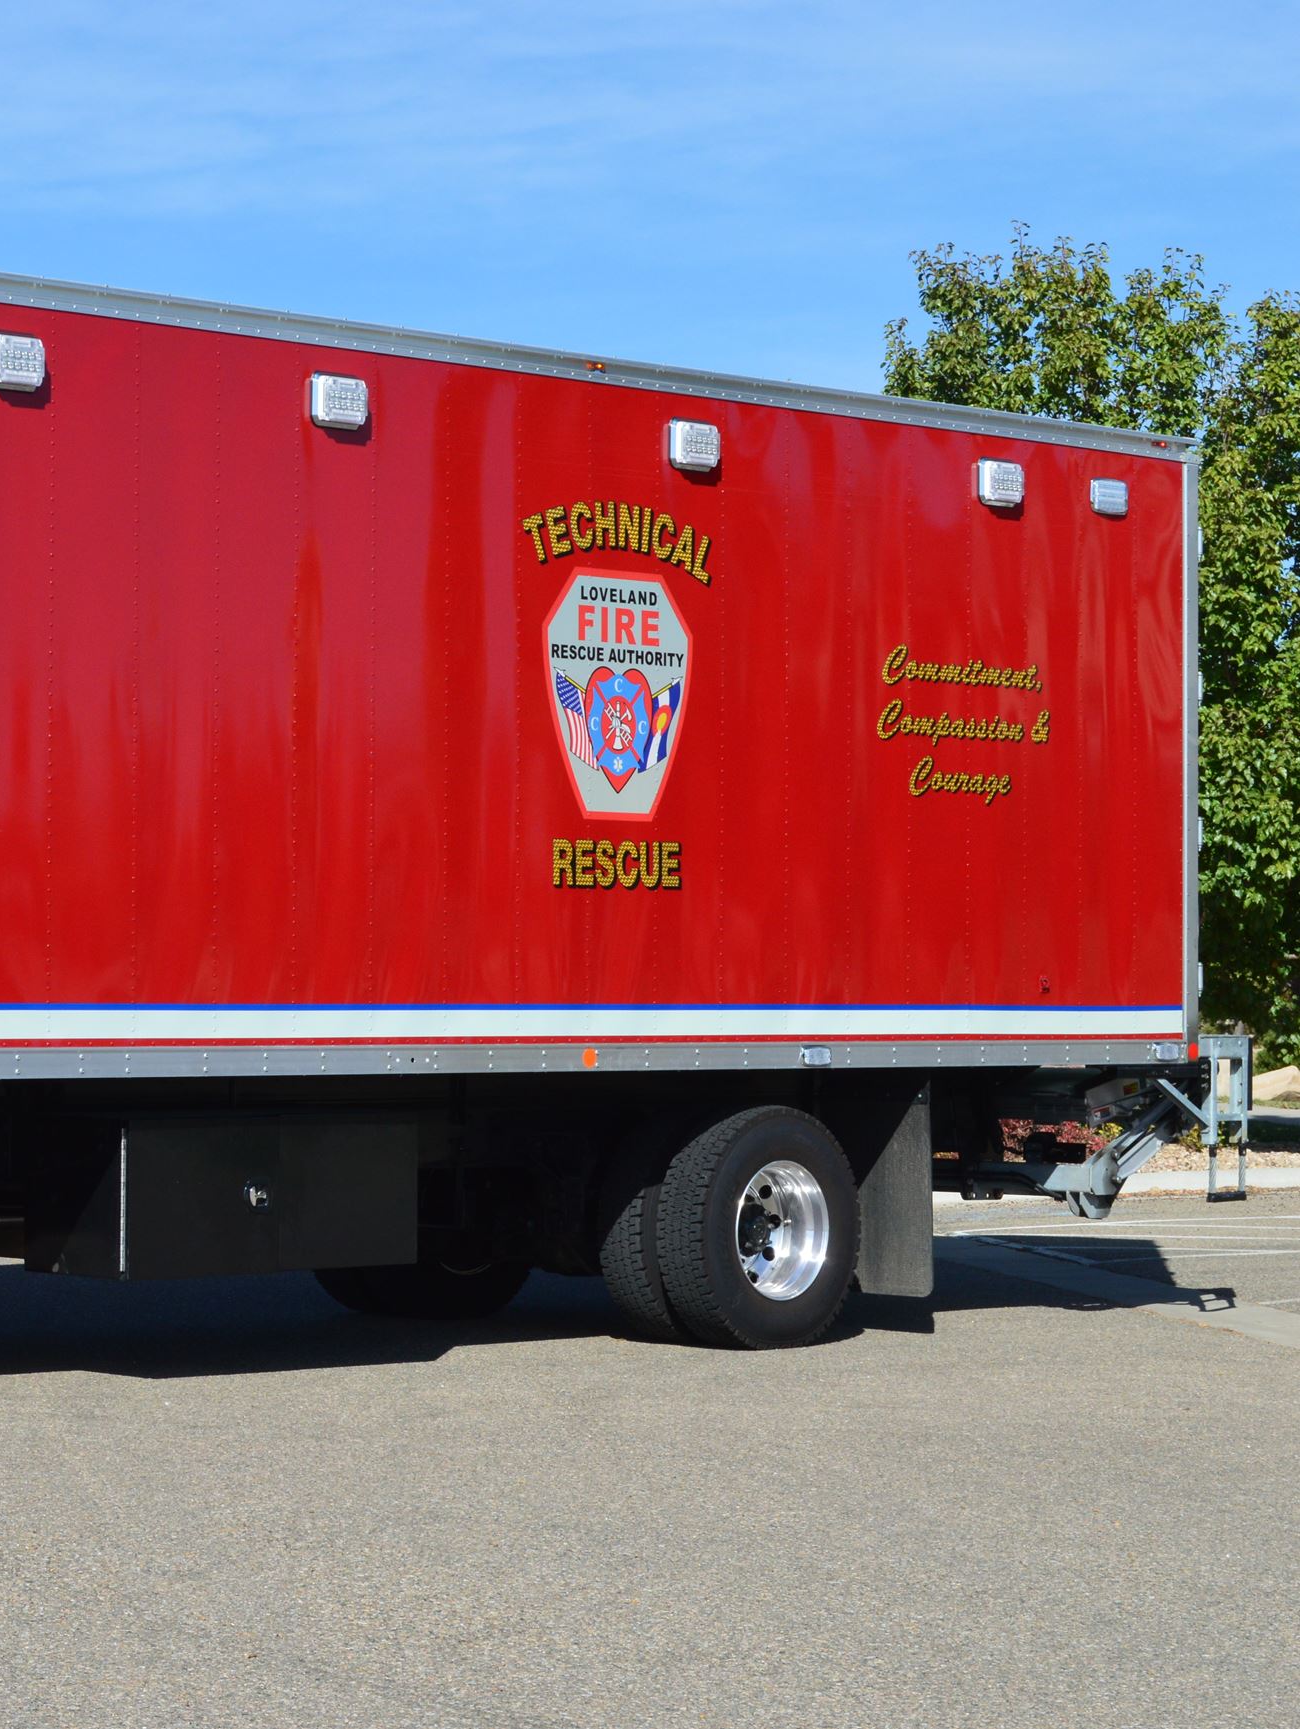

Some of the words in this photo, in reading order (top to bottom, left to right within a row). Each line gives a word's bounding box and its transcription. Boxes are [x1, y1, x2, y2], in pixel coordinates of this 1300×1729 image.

[522, 500, 712, 587] TECHNICAL
[580, 585, 657, 606] LOVELAND
[578, 604, 660, 647] FIRE
[551, 643, 604, 662] RESCUE
[608, 649, 684, 668] AUTHORITY
[881, 643, 1043, 693] Commitment,
[614, 678, 623, 693] C
[590, 716, 599, 731] C
[638, 720, 647, 735] C
[876, 697, 1025, 747] Compassion
[1030, 709, 1050, 744] &
[908, 754, 1011, 806] Courage
[552, 838, 682, 889] RESCUE
